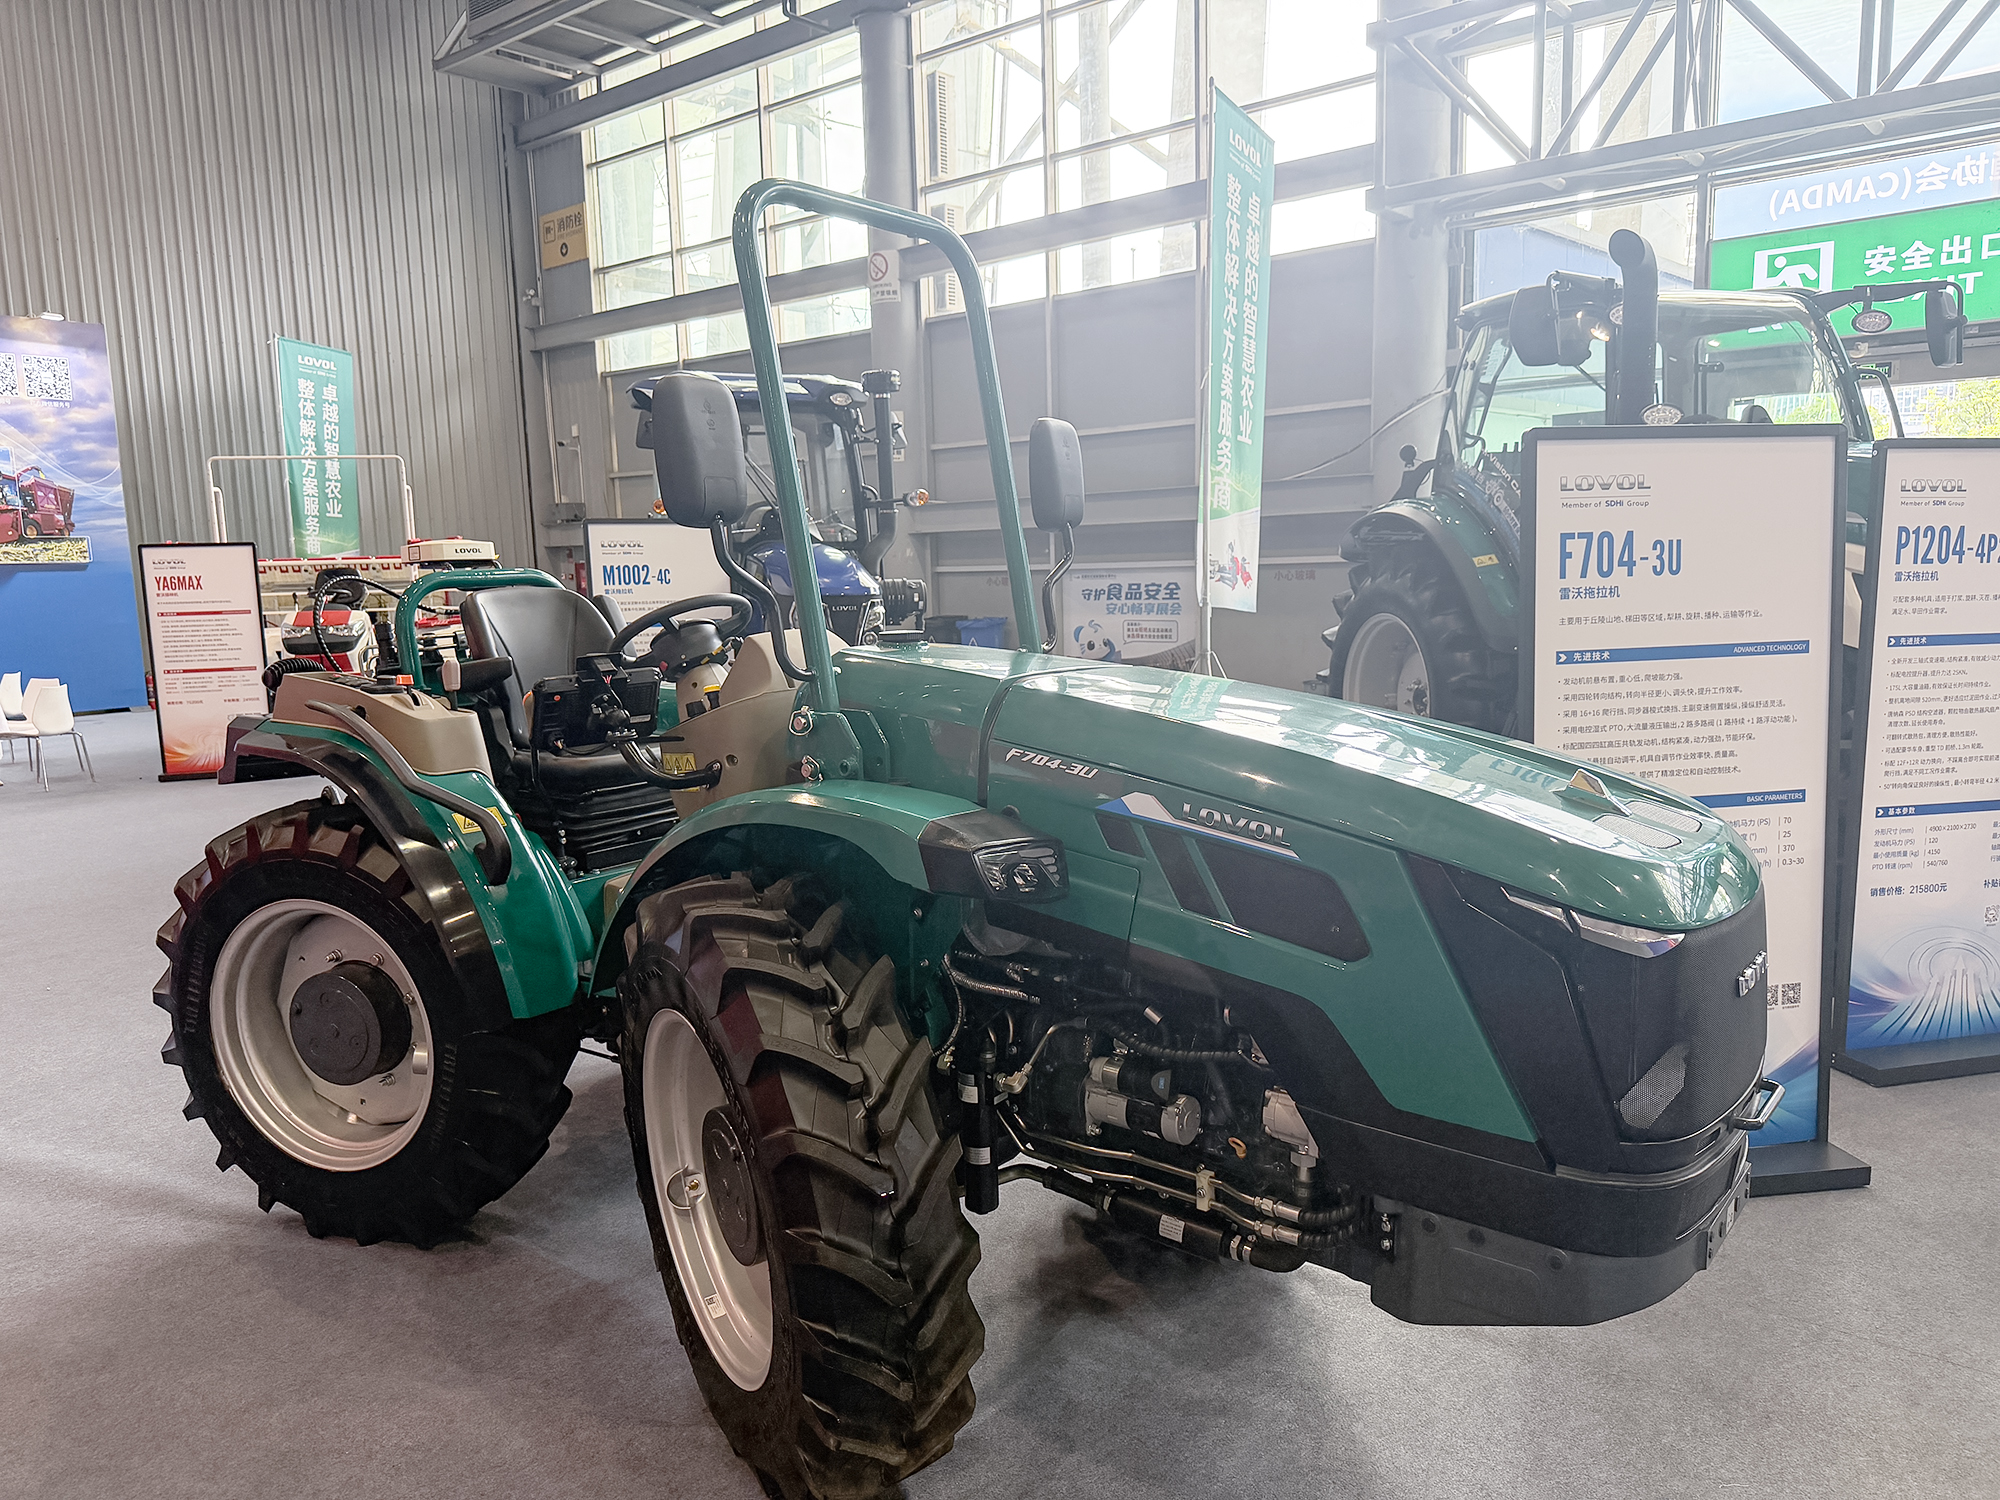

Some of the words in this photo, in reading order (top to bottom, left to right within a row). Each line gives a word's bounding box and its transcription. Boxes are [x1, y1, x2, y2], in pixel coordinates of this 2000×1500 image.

[1228, 127, 1262, 169] LOVOL
[1863, 233, 2000, 277] 安全出口
[1237, 191, 1261, 446] 卓越的智慧农业
[1213, 172, 1241, 510] 整体解决方案服务商
[297, 354, 338, 371] LOVOL
[322, 382, 343, 518] 卓越的智慧农业
[297, 377, 321, 555] 整体解决方案服务商
[1559, 473, 1652, 492] LOVOL
[1900, 478, 1967, 492] LOVOL
[1626, 500, 1650, 508] Group
[600, 539, 644, 548] LOVOL
[1895, 525, 2000, 565] P1204-4P
[1559, 530, 1682, 580] F704-3U
[602, 564, 671, 586] M1002-4C
[1273, 568, 1316, 581] 小心玻璃
[1894, 571, 1939, 582] 雷沃拖拉机
[154, 575, 203, 591] YA6MAX
[1081, 582, 1181, 601] 守护食品安全
[1559, 585, 1621, 600] 雷沃拖拉机
[831, 604, 858, 612] LOVOL
[1105, 602, 1182, 616] 安心畅享展会
[1899, 636, 1927, 645] 先进技术
[1733, 645, 1766, 653] ADVANCED
[1766, 643, 1807, 652] TECHNOLOGY
[1573, 650, 1611, 662] 先进技术
[1005, 747, 1099, 779] F704-3U
[1746, 794, 1764, 803] BASIC
[1765, 792, 1803, 802] PARAMETERS
[1888, 807, 1916, 816] 基本参数
[1181, 801, 1291, 847] LOVOL
[1757, 818, 1771, 827] (PS)
[1783, 816, 1792, 824] 70
[1782, 844, 1796, 852] 370
[1782, 858, 1805, 866] 0.3~30
[1909, 882, 1948, 894] 215800元
[1983, 878, 2000, 889] 补贴
